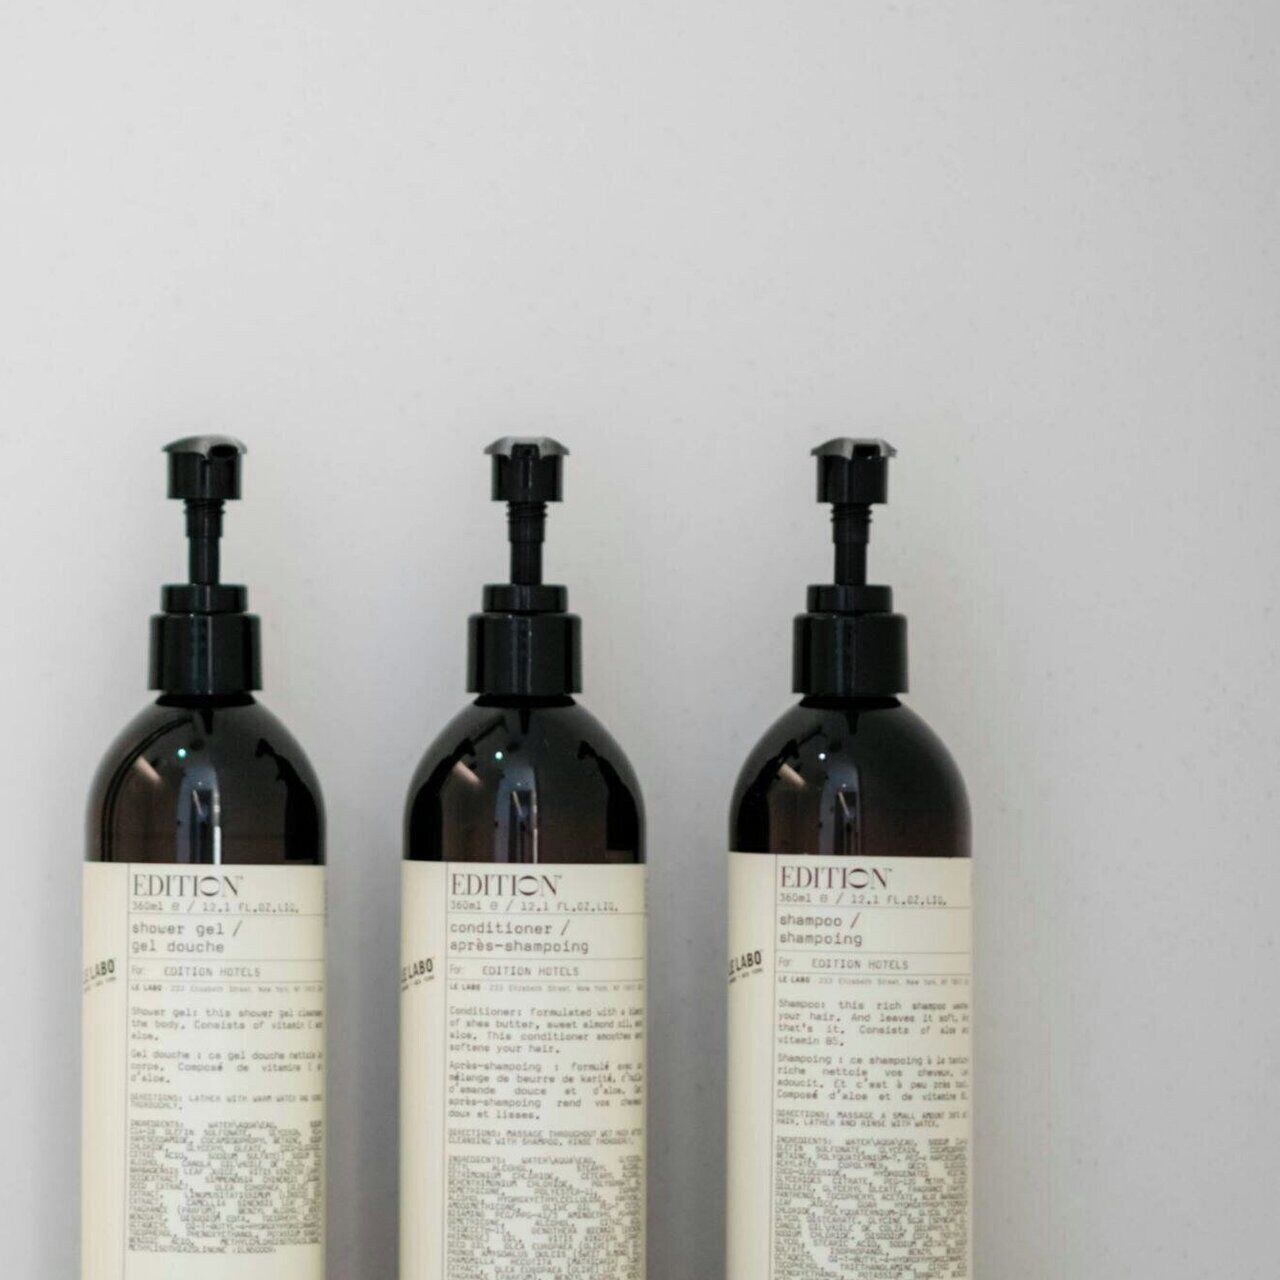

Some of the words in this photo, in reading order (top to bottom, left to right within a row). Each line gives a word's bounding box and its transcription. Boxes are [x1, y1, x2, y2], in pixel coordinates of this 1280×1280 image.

[781, 866, 889, 889] EDITION
[134, 875, 239, 897] EDITION
[451, 873, 558, 896] EDITION
[779, 893, 811, 903] 360ml
[851, 894, 878, 904] 12.1
[132, 902, 163, 911] 360ml
[203, 902, 230, 912] 12.1
[450, 901, 482, 911] 360ml
[521, 902, 548, 911] 12.1
[780, 916, 842, 928] shampoo
[132, 922, 185, 935] shower
[196, 923, 224, 937] gel
[450, 922, 553, 935] conditioner
[780, 933, 863, 947] shampoing
[131, 940, 156, 953] gel
[166, 941, 224, 953] douche
[450, 938, 589, 954] après-shampoing
[736, 950, 761, 971] LABO
[812, 958, 861, 970] EDITION
[869, 959, 909, 970] HOTELS
[164, 967, 213, 977] EDITION
[220, 967, 260, 977] HOTELS
[482, 966, 531, 976] EDITION
[538, 966, 579, 977] HOTELS
[779, 1000, 825, 1010] Shampoo:
[839, 1001, 864, 1010] this
[876, 1002, 901, 1010] rich
[131, 1007, 165, 1016] Shower
[206, 1009, 231, 1017] this
[239, 1009, 273, 1017] shower
[450, 1007, 522, 1017] Conditioner:
[530, 1007, 591, 1017] formulated
[779, 1012, 801, 1021] your
[810, 1012, 841, 1022] hair.
[851, 1013, 870, 1022] And
[880, 1013, 915, 1023] leaves
[132, 1020, 148, 1028] the
[194, 1021, 245, 1030] Consists
[253, 1021, 265, 1030] of
[450, 1019, 460, 1028] of
[547, 1021, 577, 1029] sweet
[583, 1020, 614, 1029] almond
[779, 1023, 813, 1033] that's
[827, 1024, 845, 1034] it.
[859, 1025, 909, 1035] Consists
[920, 1026, 931, 1034] of
[487, 1032, 512, 1041] This
[521, 1032, 588, 1041] conditioner
[778, 1036, 819, 1045] vitamin
[450, 1043, 490, 1052] softens
[497, 1045, 522, 1054] your
[528, 1044, 560, 1054] hair.
[154, 1051, 190, 1059] douche
[228, 1052, 245, 1062] gel
[252, 1052, 284, 1060] douche
[778, 1053, 832, 1065] Shampoing
[850, 1056, 863, 1065] ce
[870, 1055, 922, 1066] shampoing
[237, 1064, 249, 1072] de
[778, 1067, 806, 1075] riche
[823, 1068, 868, 1076] nettoie
[885, 1069, 903, 1077] vos
[497, 1075, 510, 1083] de
[517, 1075, 555, 1084] beurre
[562, 1075, 574, 1083] de
[515, 1086, 547, 1095] douce
[565, 1087, 576, 1095] et
[879, 1093, 891, 1101] et
[902, 1092, 913, 1101] de
[558, 1099, 581, 1107] rend
[448, 1110, 470, 1118] doux
[477, 1111, 489, 1119] et
